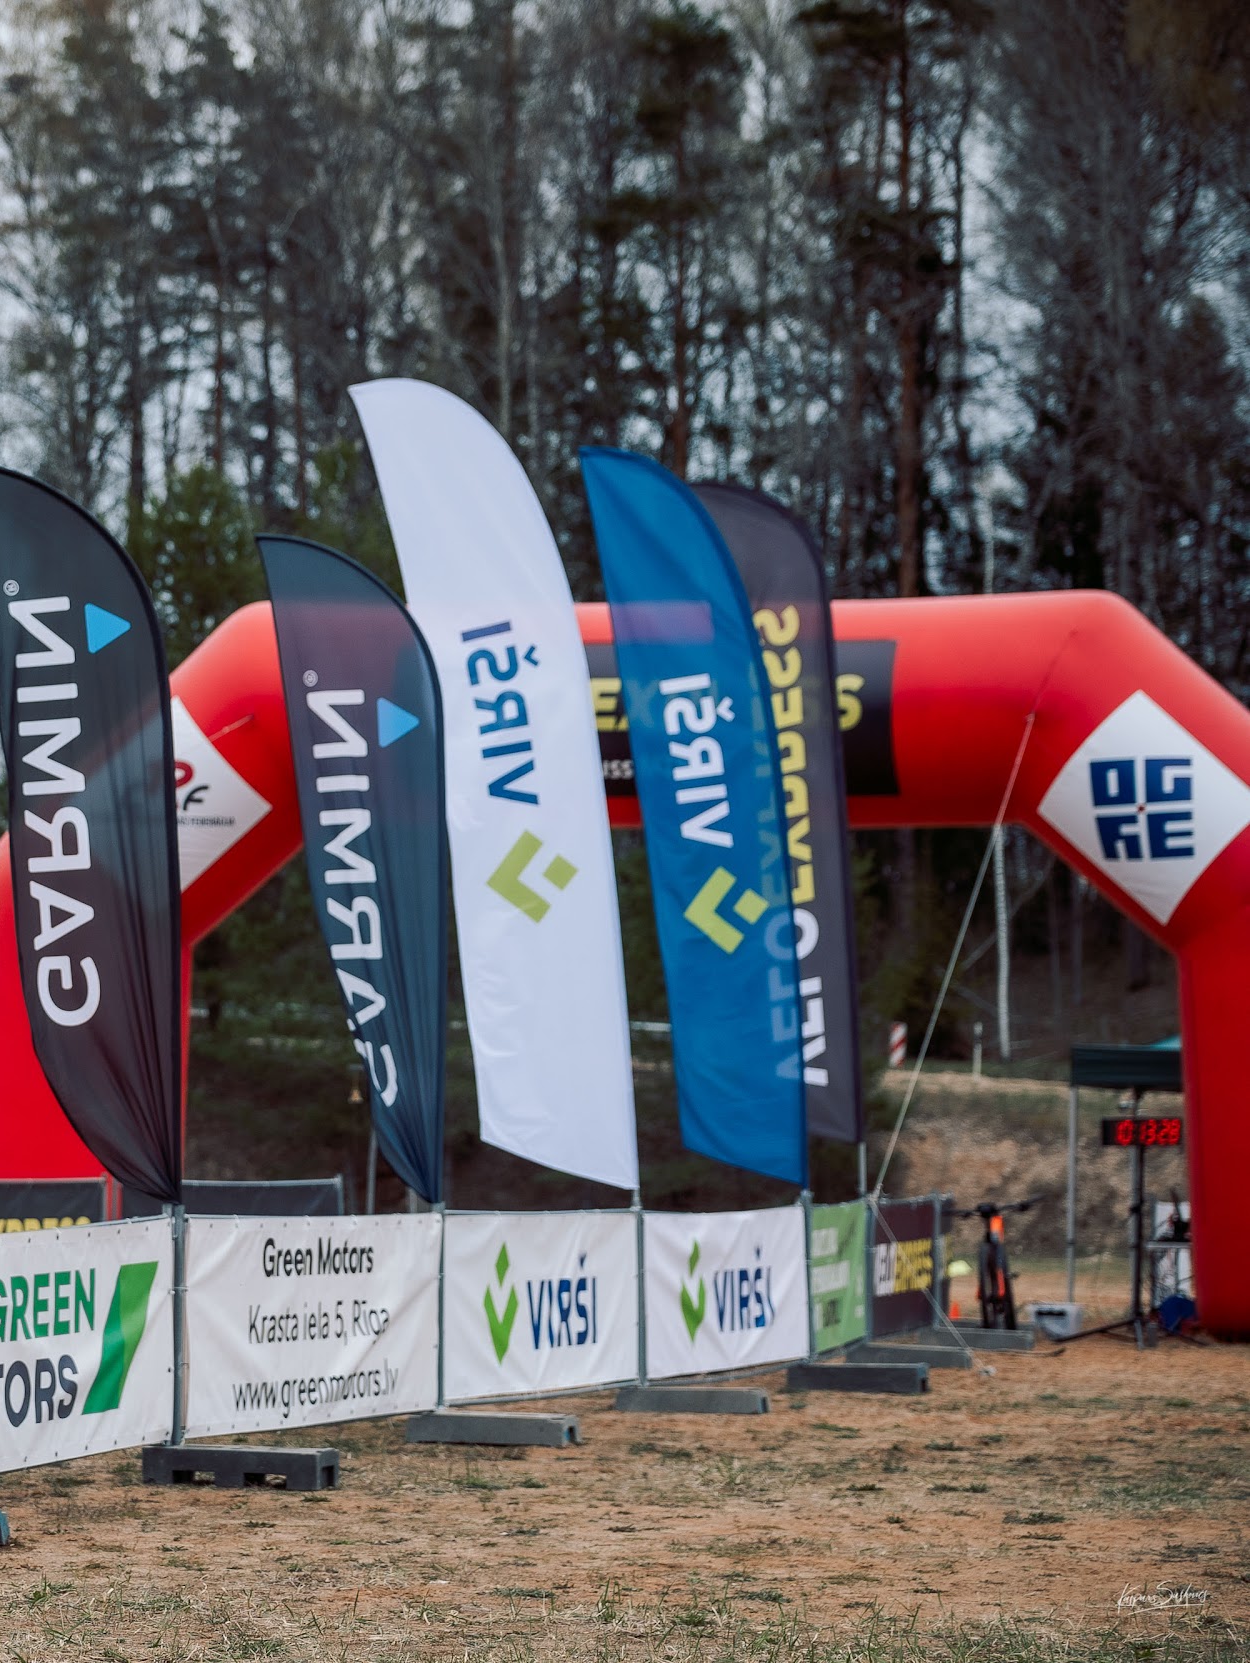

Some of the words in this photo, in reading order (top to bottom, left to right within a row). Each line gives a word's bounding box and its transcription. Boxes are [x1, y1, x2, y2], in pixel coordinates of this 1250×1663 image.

[262, 1237, 313, 1278] Green
[317, 1236, 374, 1275] Motors
[713, 1245, 776, 1332] VIRŠI
[248, 1304, 299, 1344] Krasta
[302, 1301, 330, 1341] iela
[527, 1252, 597, 1350] VIRŠI
